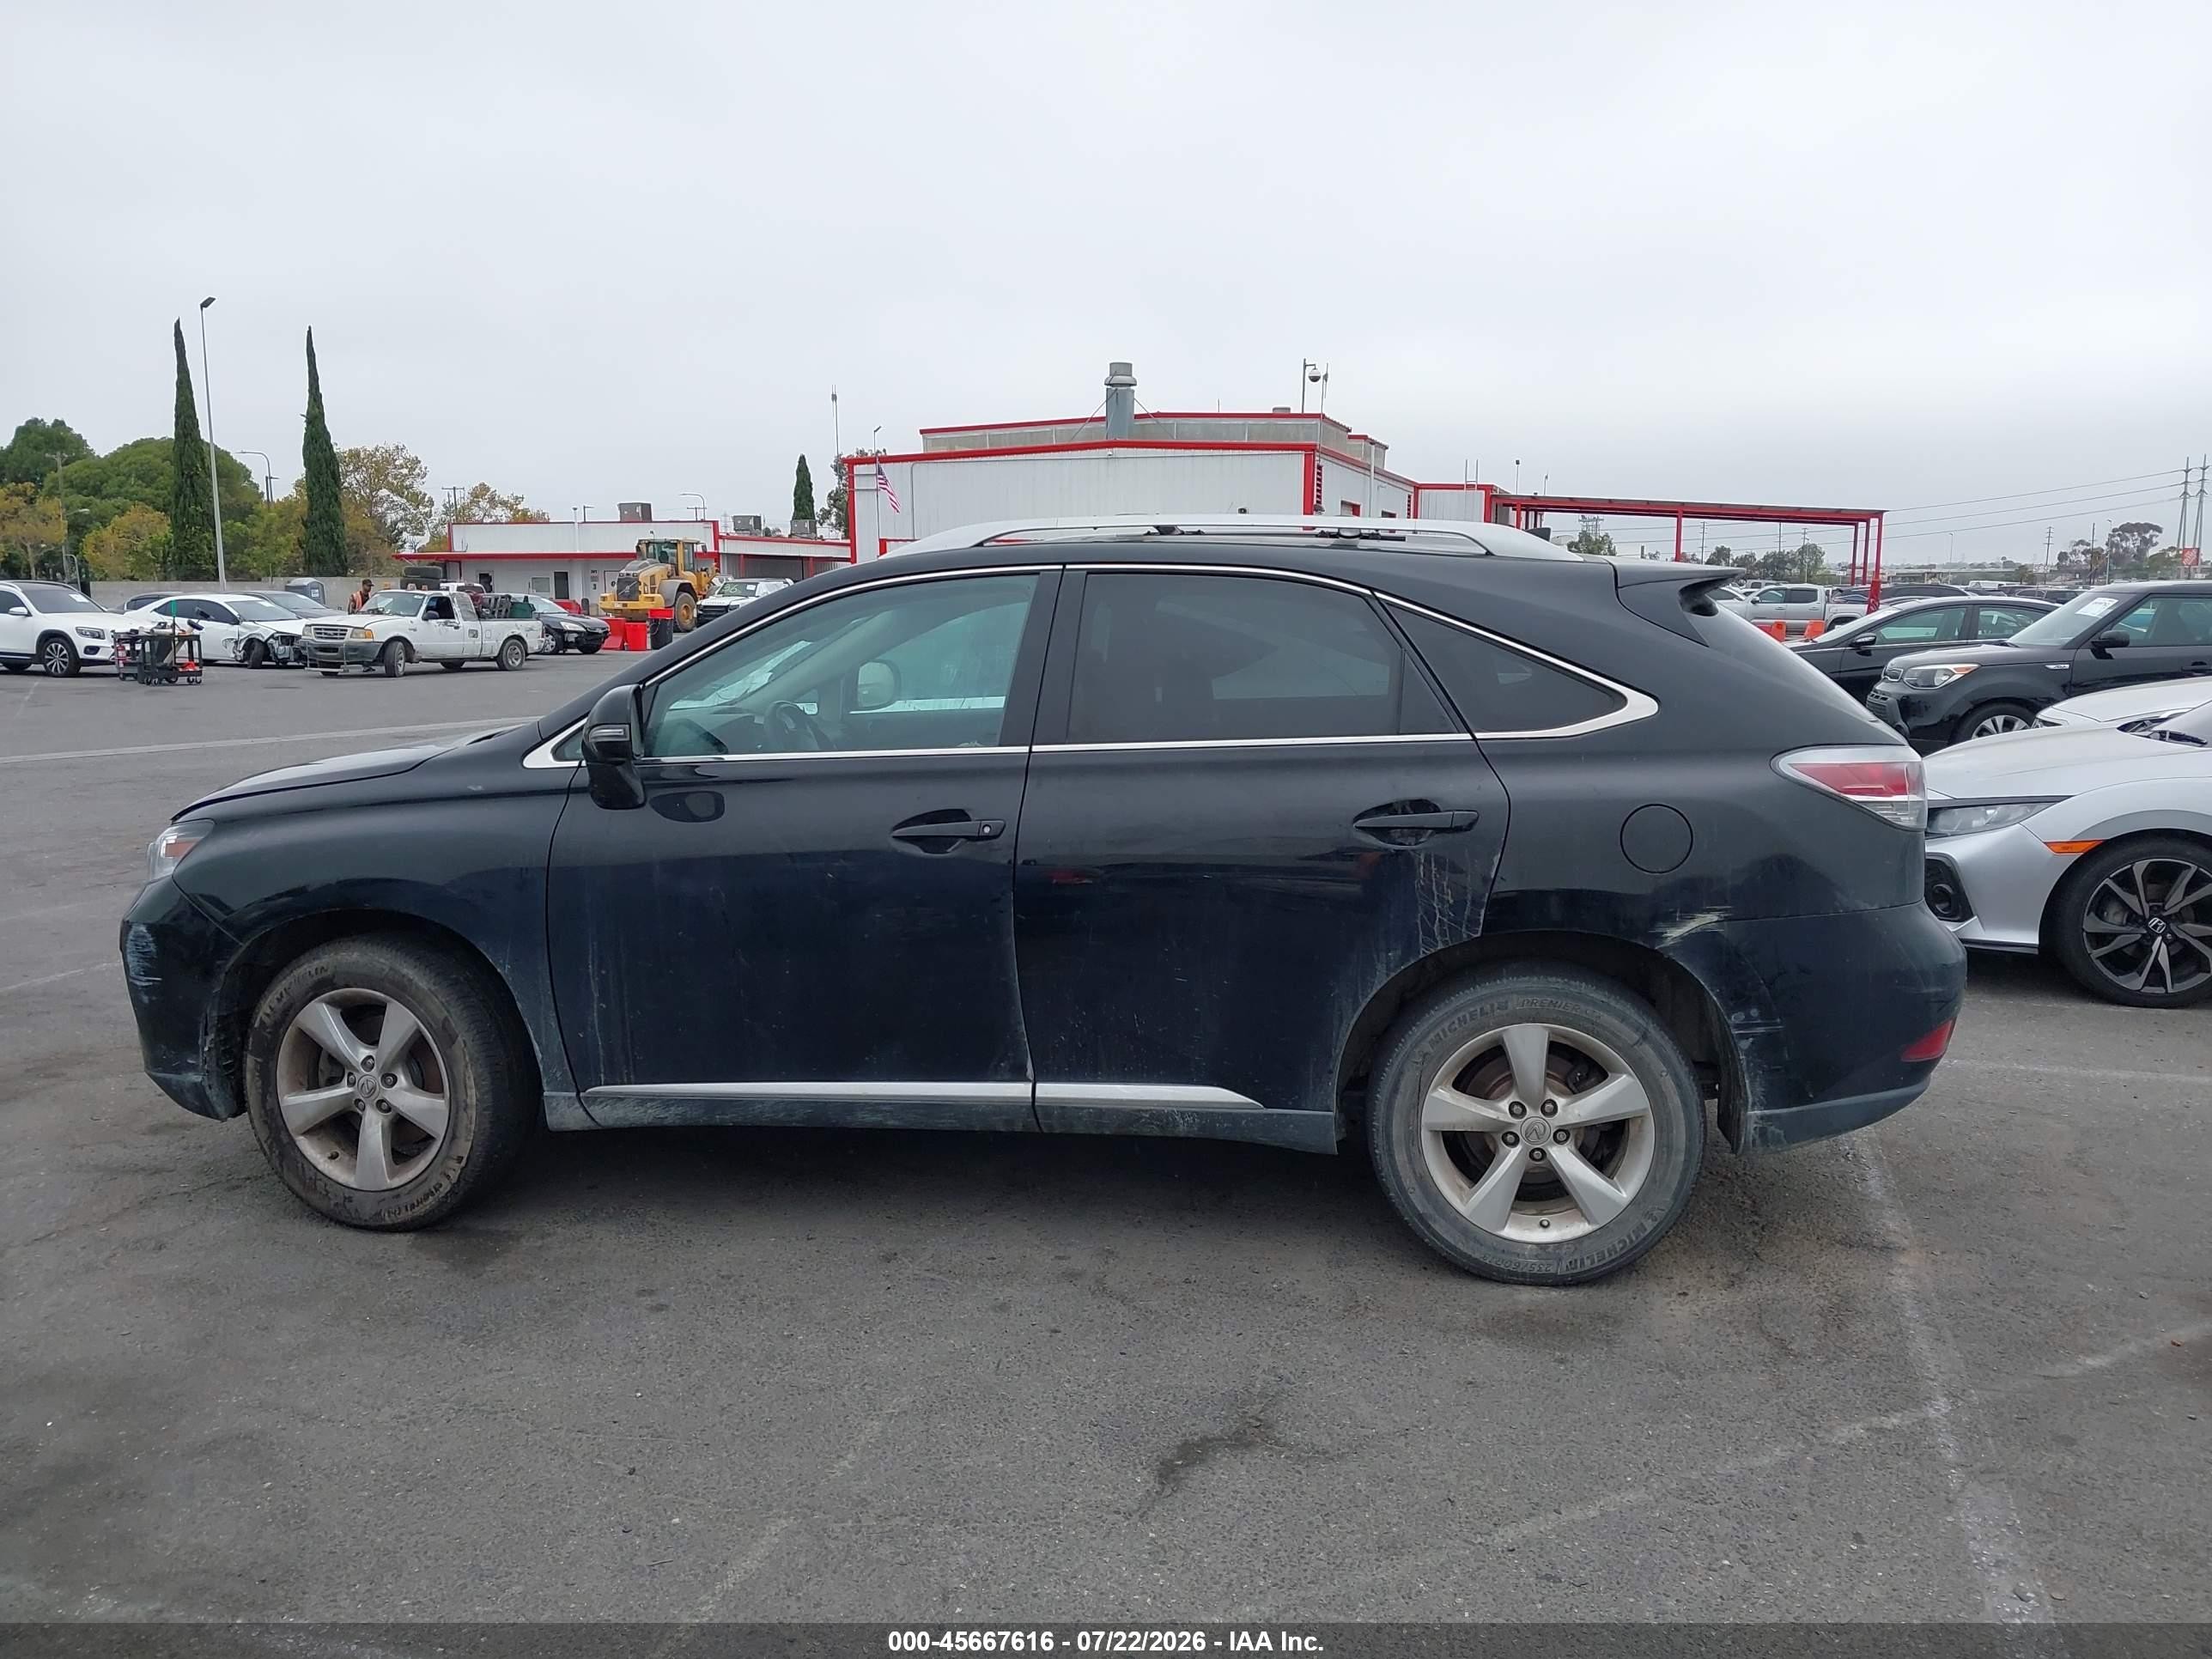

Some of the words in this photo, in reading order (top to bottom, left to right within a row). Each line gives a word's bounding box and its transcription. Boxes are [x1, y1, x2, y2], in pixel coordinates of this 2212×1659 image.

[1428, 1000, 1509, 1050] MICHELIN
[1520, 997, 1582, 1014] PREMIER
[1565, 1224, 1649, 1273] MICHELIN
